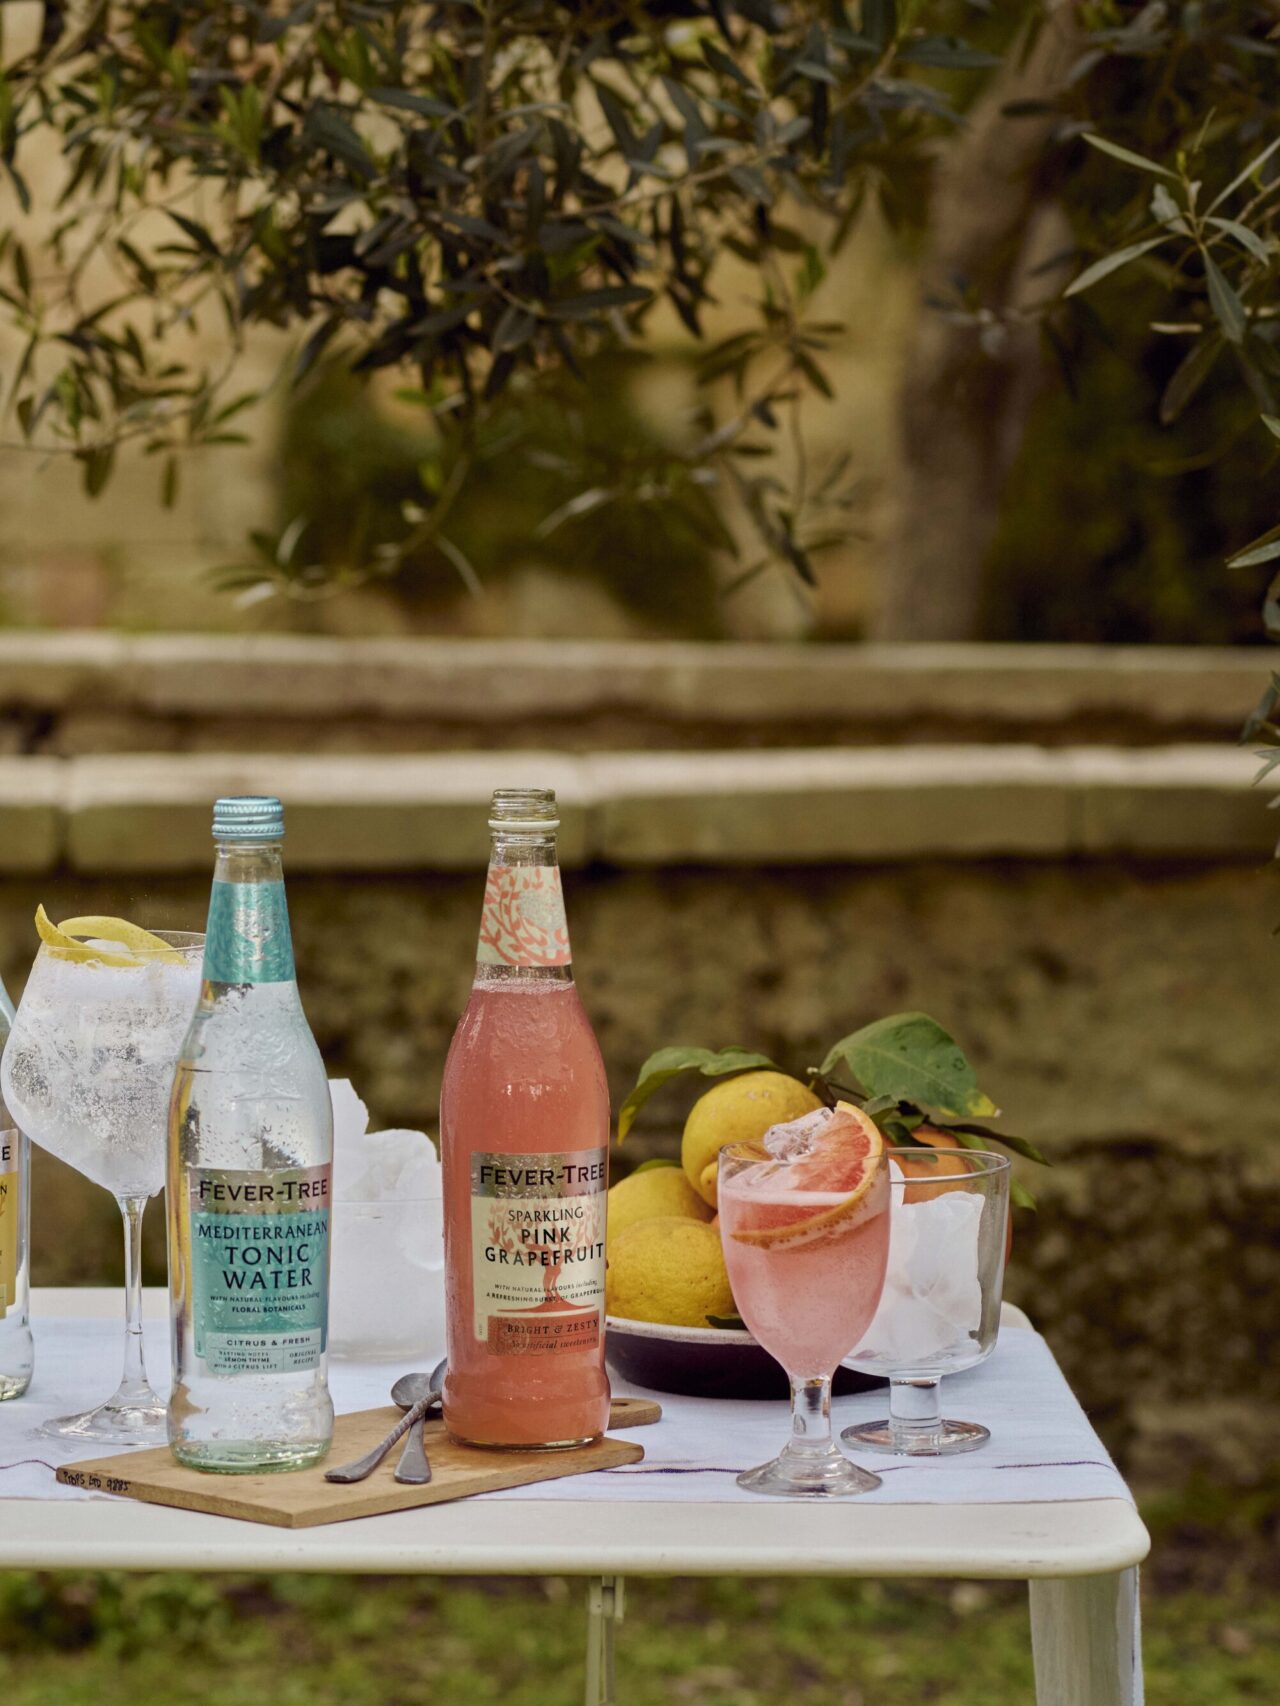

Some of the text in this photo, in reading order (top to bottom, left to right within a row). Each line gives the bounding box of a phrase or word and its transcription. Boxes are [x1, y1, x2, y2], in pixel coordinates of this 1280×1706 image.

[480, 1162, 605, 1186] FEVER-TREE
[199, 1178, 328, 1202] FEVER-TREE
[508, 1206, 584, 1222] SPARKLING
[198, 1219, 328, 1241] MEDITERRANEAN
[521, 1226, 570, 1245] PINK
[224, 1243, 310, 1265] TONIC
[485, 1242, 604, 1266] GRAPEFRUIT
[222, 1268, 313, 1290] WATER
[543, 1284, 575, 1293] FLAVOURS
[575, 1279, 598, 1289] including
[265, 1295, 298, 1303] FLAVOURS
[491, 1292, 534, 1303] REFRESHING
[263, 1304, 306, 1313] BOTANICALS
[507, 1319, 599, 1334] BRIGHT & ZESTY
[226, 1339, 267, 1347] CITRUS
[282, 1337, 311, 1345] FRESH
[289, 1349, 317, 1358] ORIGINAL
[106, 1478, 131, 1491] 9885
